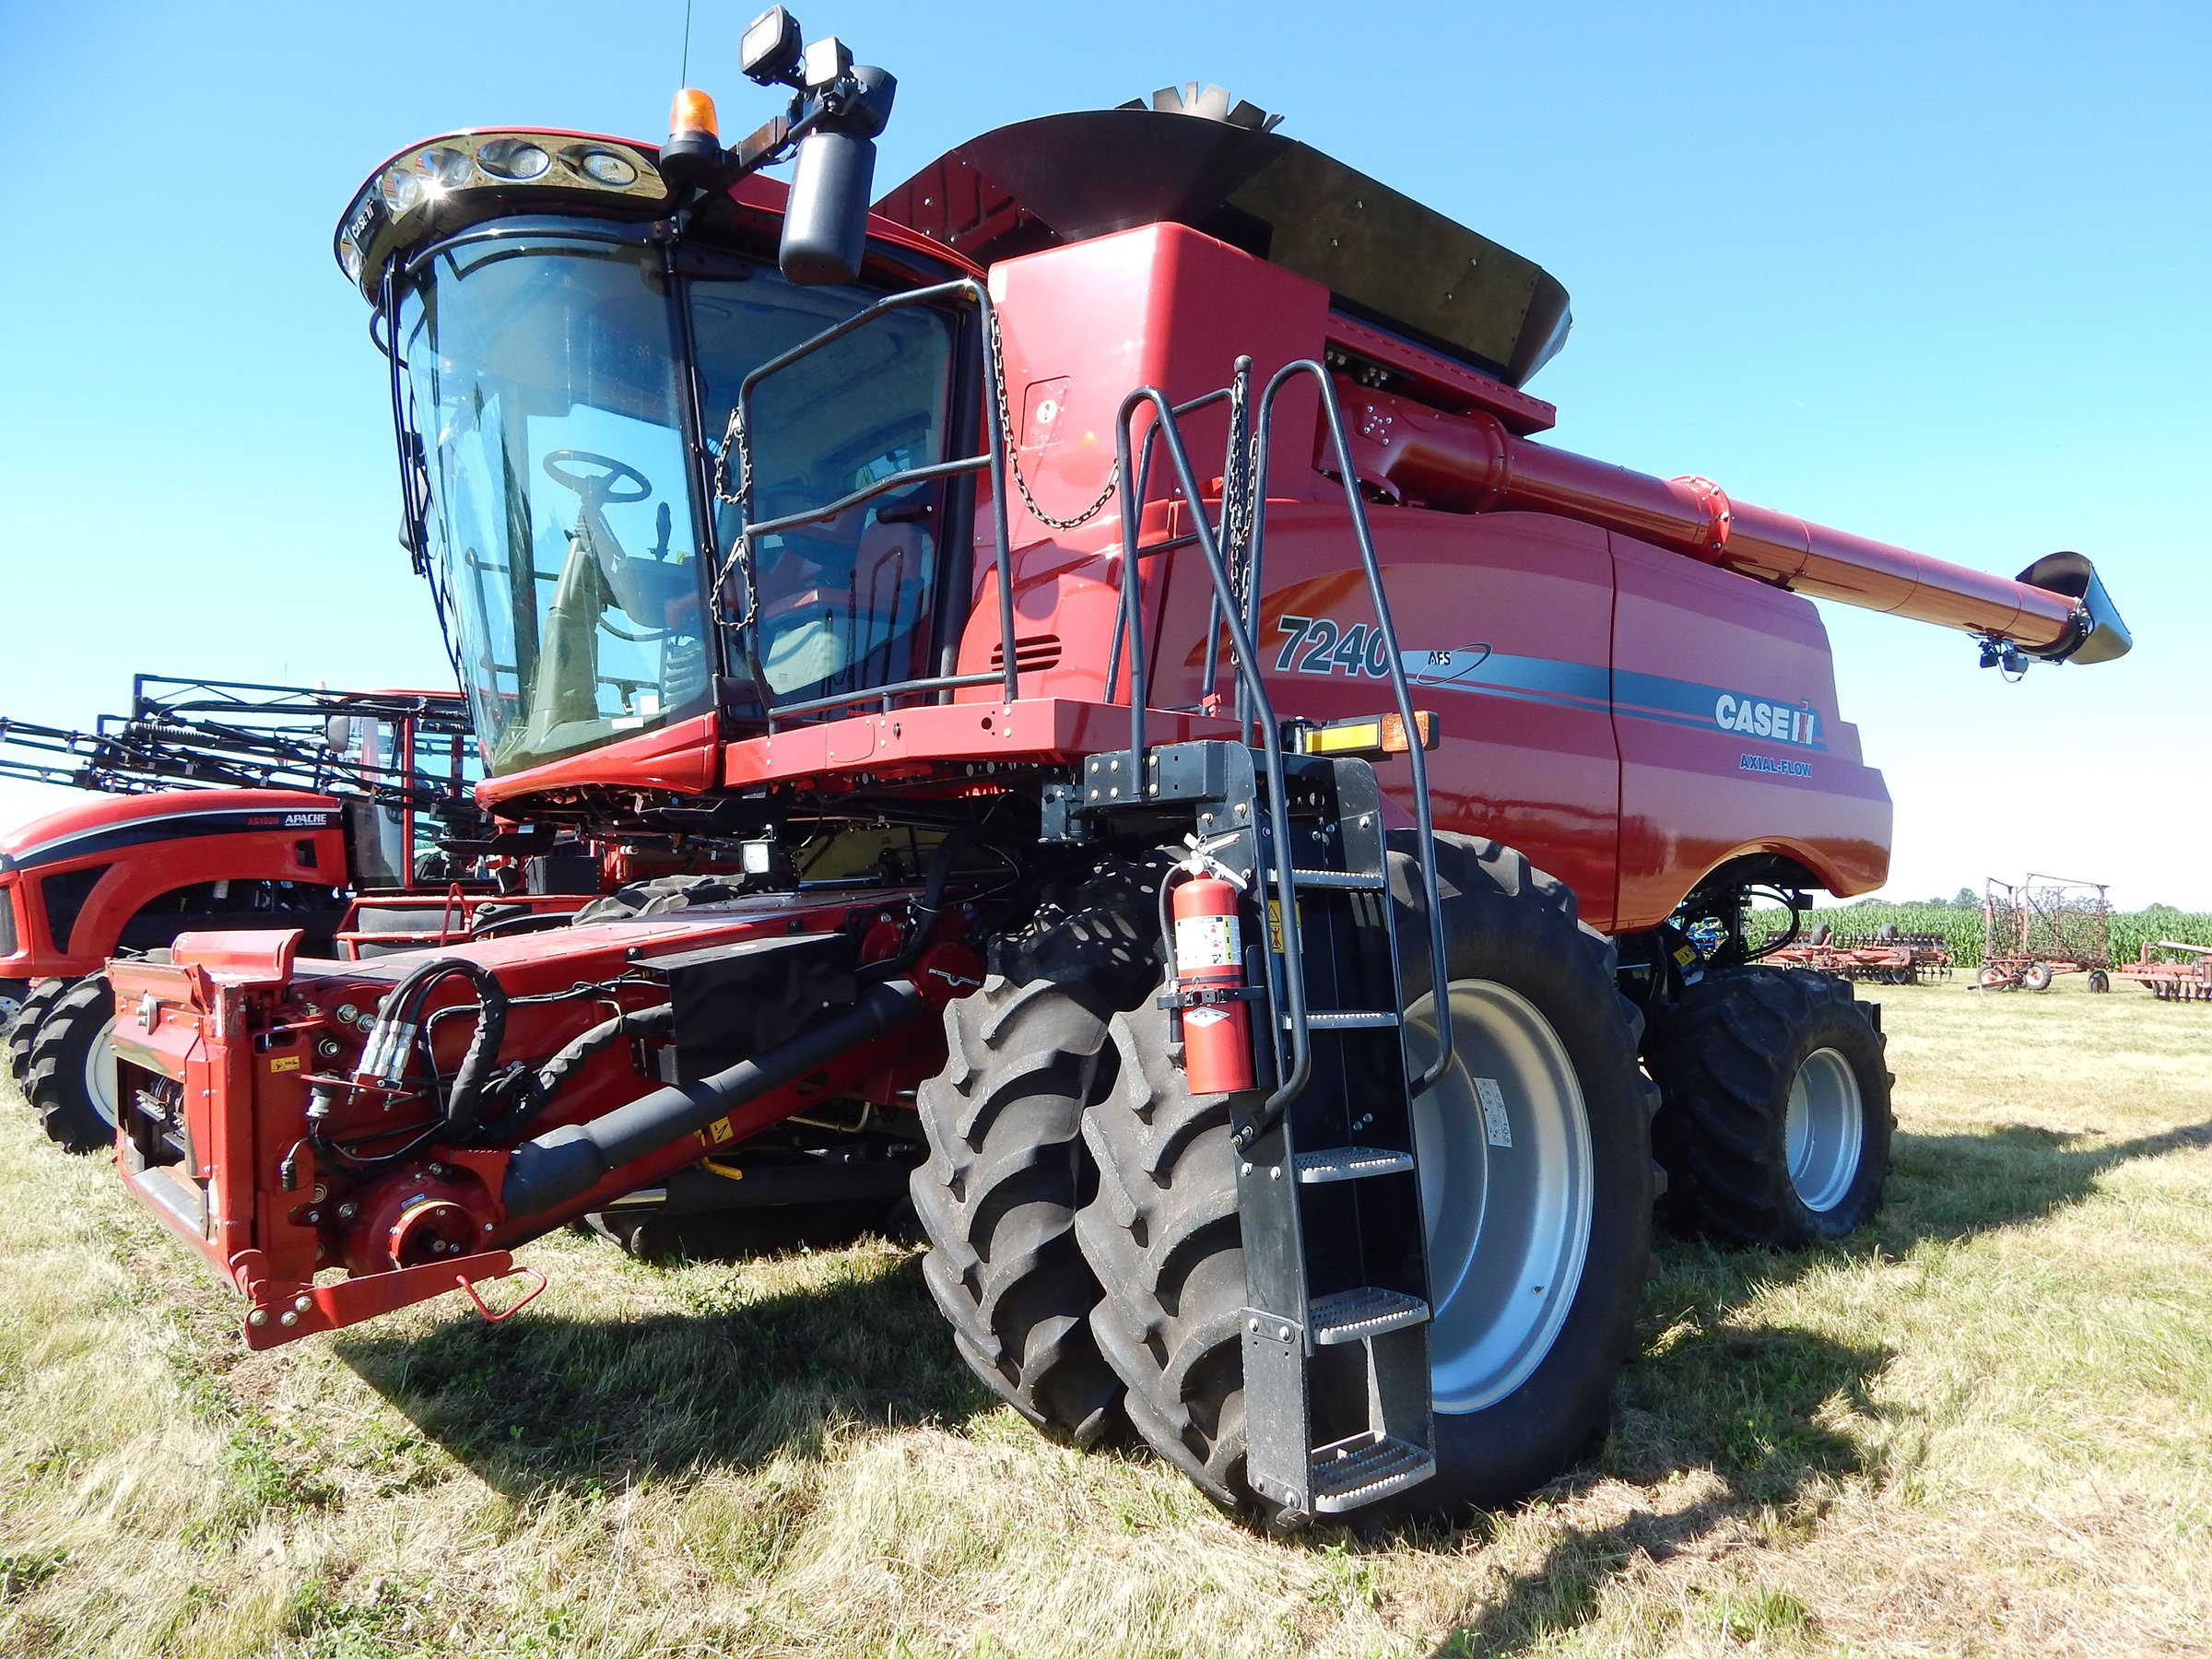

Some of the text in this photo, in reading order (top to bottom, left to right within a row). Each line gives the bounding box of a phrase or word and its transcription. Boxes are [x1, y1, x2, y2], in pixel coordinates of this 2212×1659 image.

[1275, 614, 1393, 679] 7240
[1428, 650, 1452, 666] AFS
[1739, 753, 1812, 778] AXIAL-FLOW
[285, 814, 327, 823] APACHE
